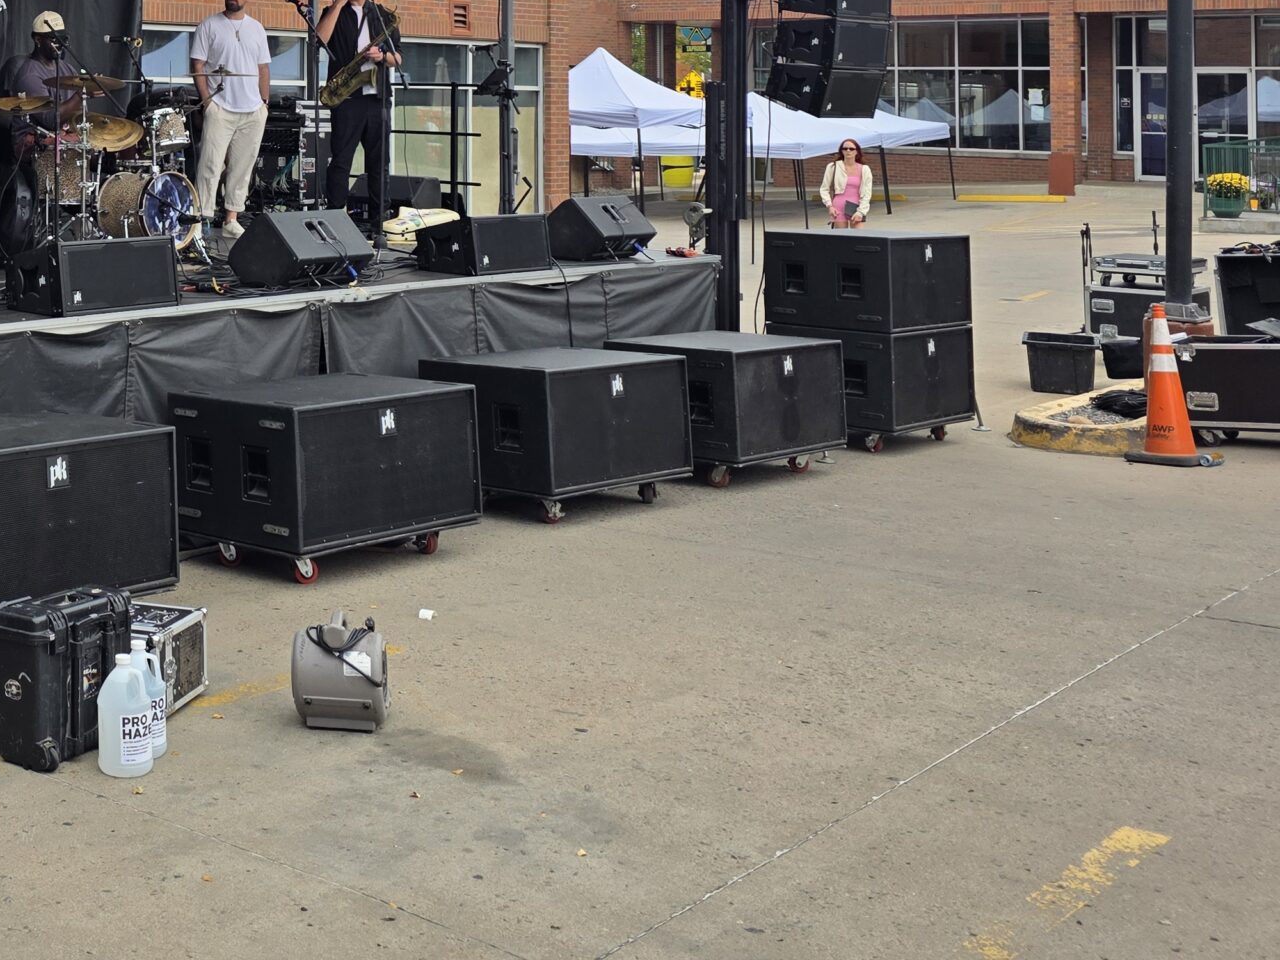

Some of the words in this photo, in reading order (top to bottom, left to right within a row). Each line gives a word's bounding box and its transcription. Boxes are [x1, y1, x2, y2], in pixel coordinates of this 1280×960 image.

[612, 374, 624, 396] pk
[381, 409, 395, 435] pk
[1151, 424, 1175, 433] AWP
[50, 456, 68, 488] pk
[151, 698, 164, 712] RO
[122, 714, 148, 728] PRO
[122, 723, 152, 740] HAZE
